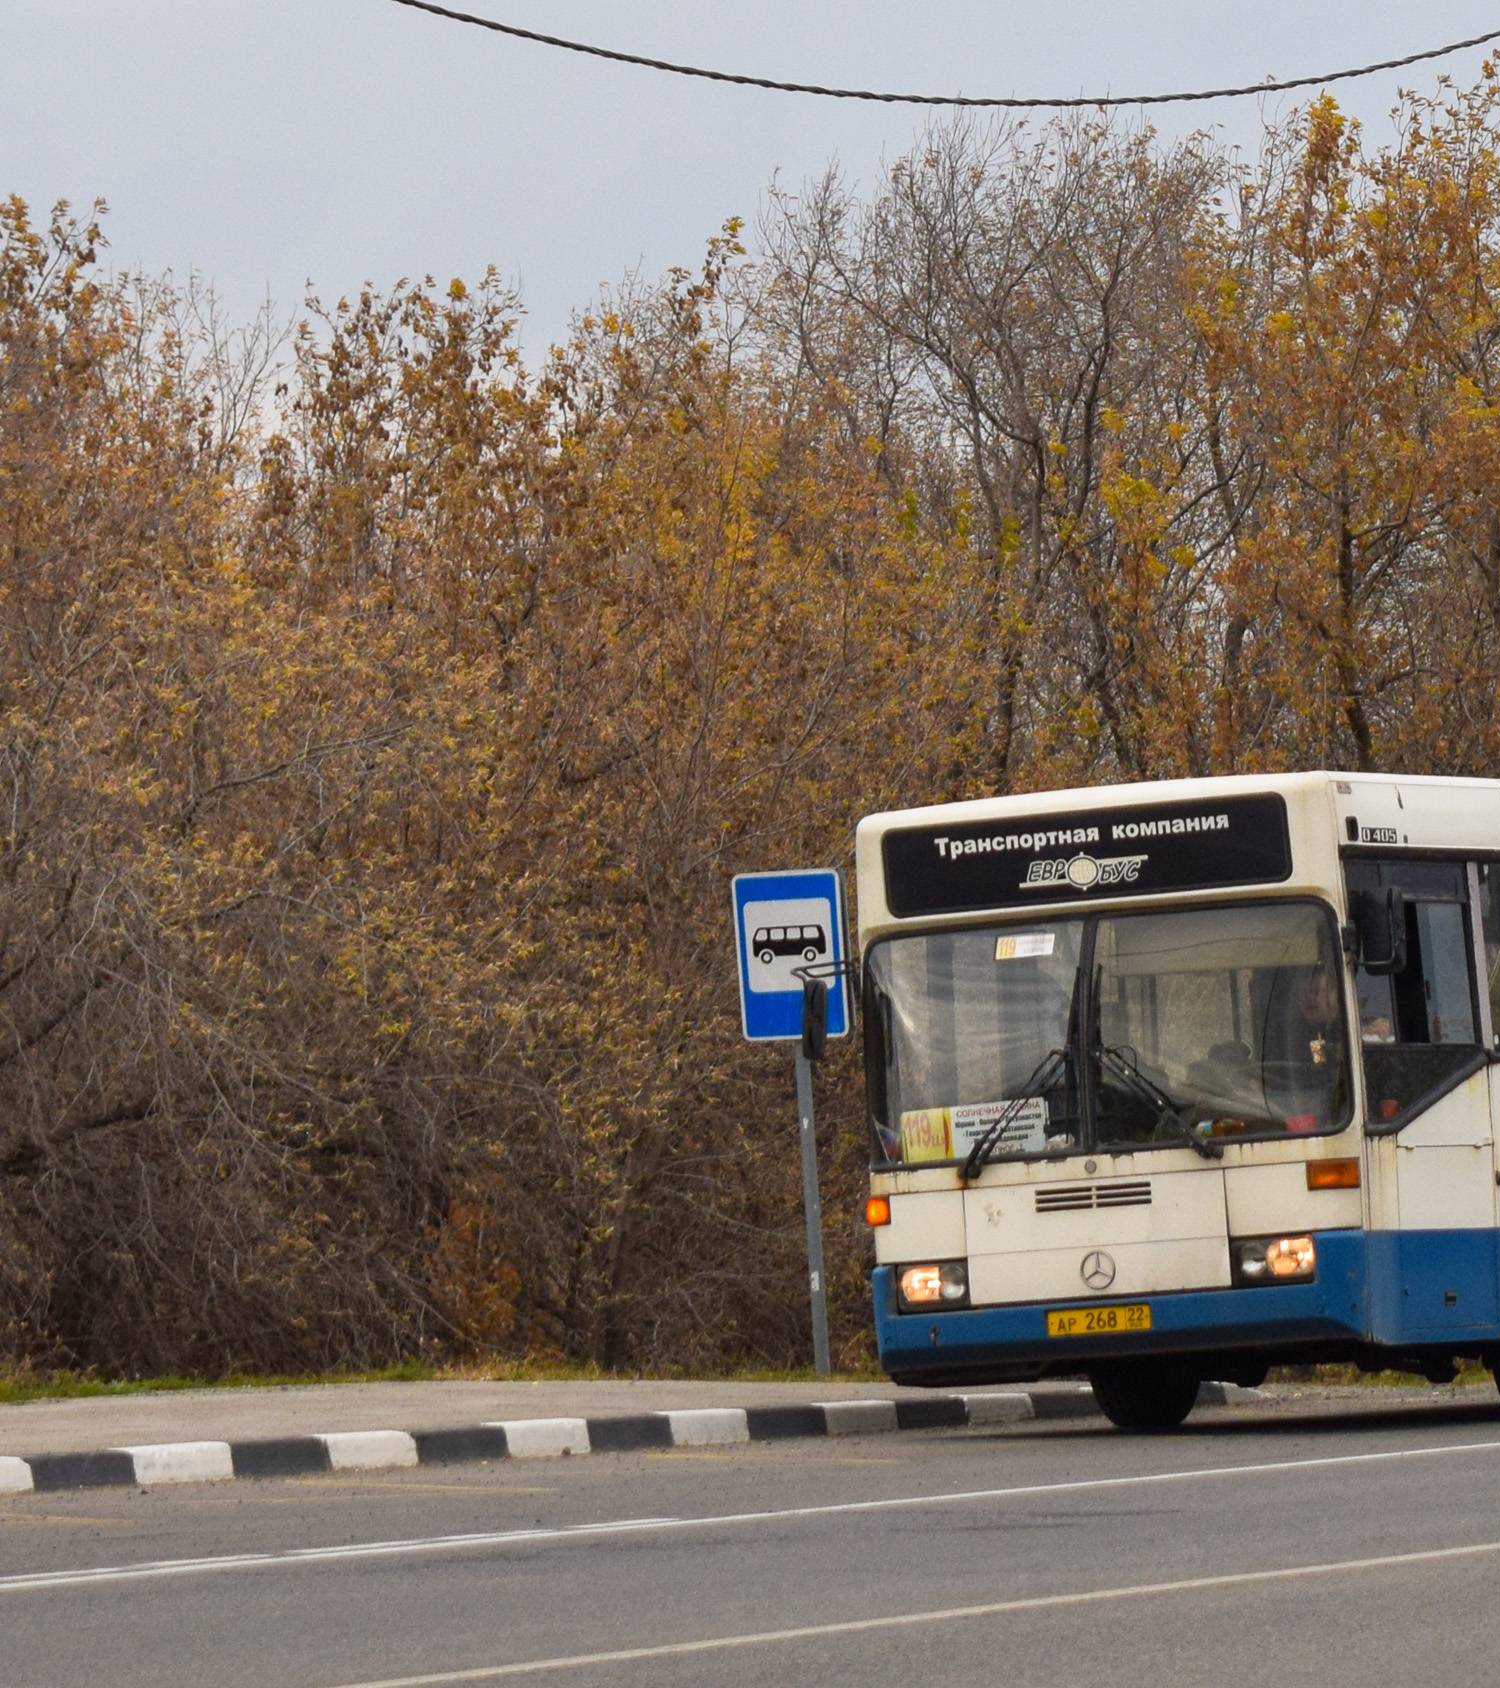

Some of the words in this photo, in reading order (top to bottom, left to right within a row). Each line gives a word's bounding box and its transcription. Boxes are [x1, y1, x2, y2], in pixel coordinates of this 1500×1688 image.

[934, 825, 1100, 860] Транспортная
[1111, 813, 1230, 840] компания
[1086, 1311, 1117, 1331] 268
[1127, 1306, 1144, 1321] 22
